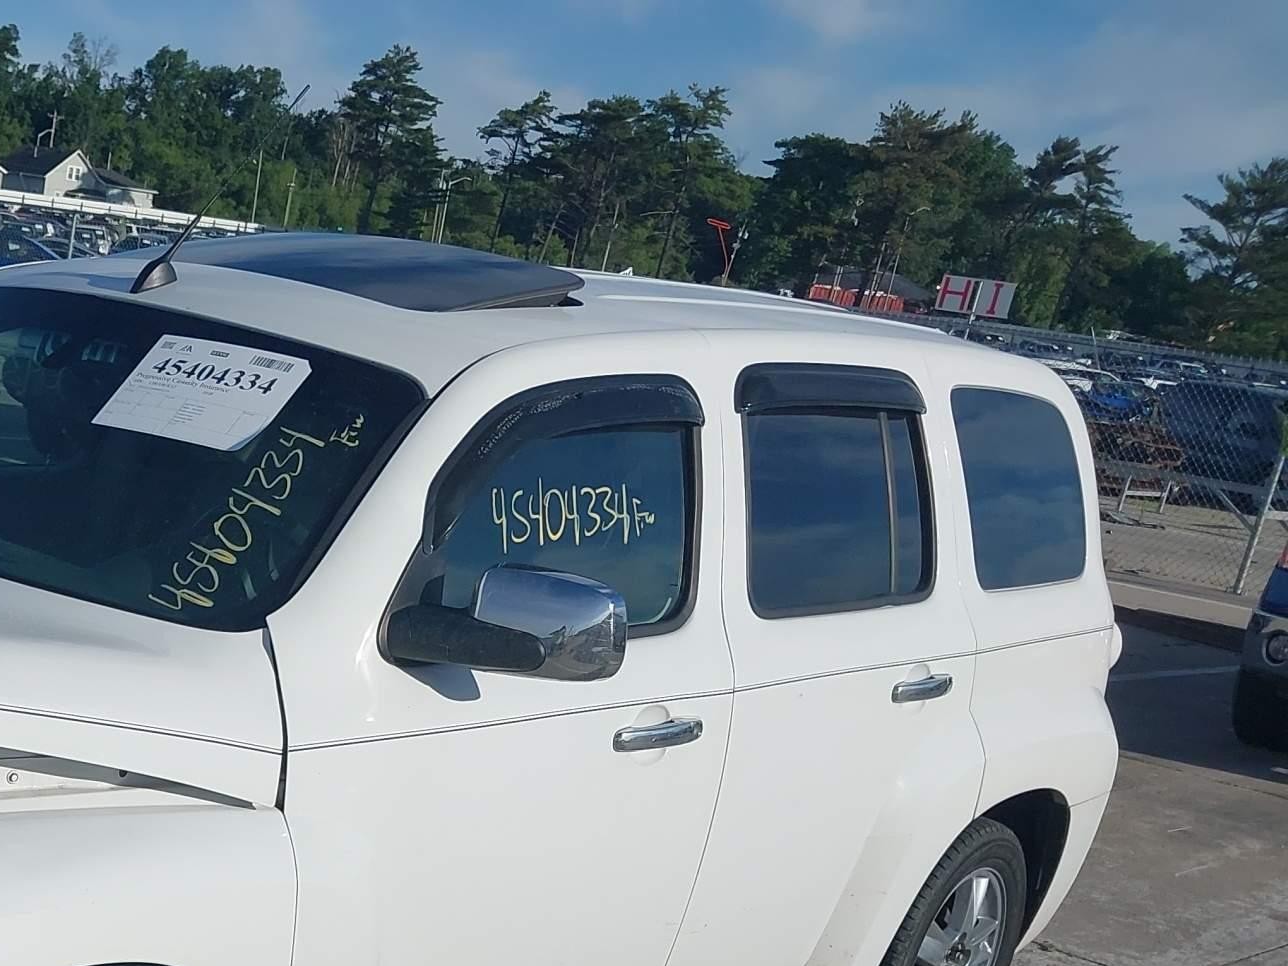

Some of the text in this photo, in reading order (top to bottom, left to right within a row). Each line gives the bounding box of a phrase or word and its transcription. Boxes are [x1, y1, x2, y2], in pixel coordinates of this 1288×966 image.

[152, 357, 279, 395] 45404334
[148, 426, 325, 610] 45404334
[492, 477, 629, 554] 45404334
